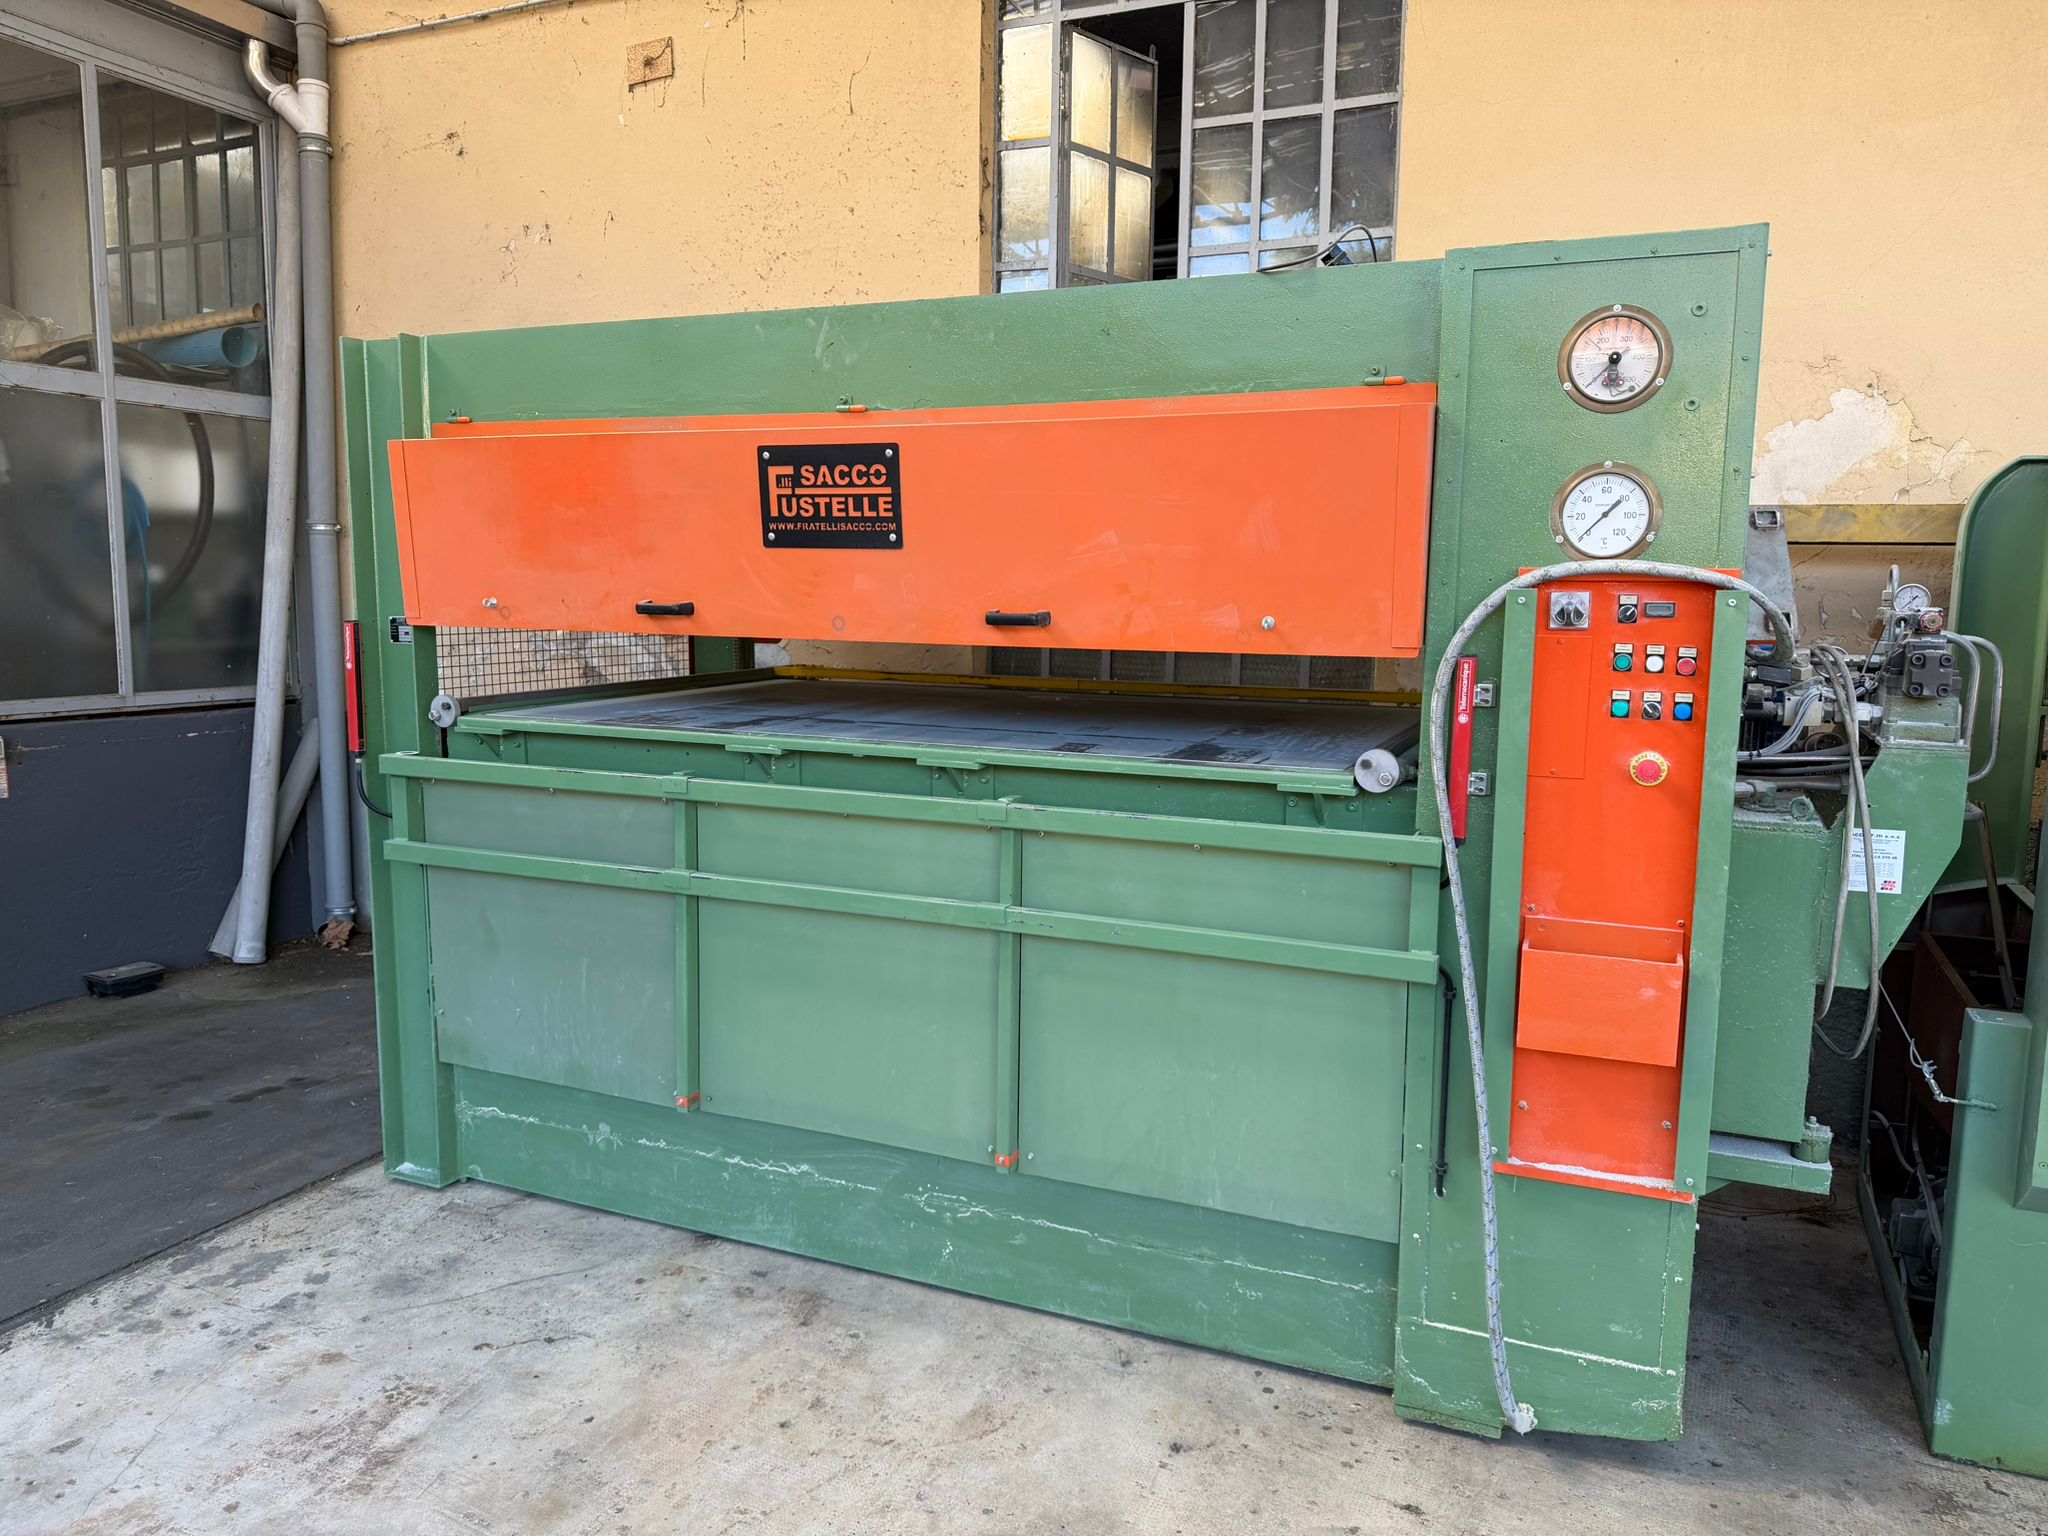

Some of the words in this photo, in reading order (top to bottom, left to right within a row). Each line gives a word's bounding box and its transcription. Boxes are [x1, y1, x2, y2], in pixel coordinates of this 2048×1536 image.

[1632, 353, 1646, 361] 400
[800, 463, 887, 485] SACCO
[1602, 486, 1612, 494] 60
[769, 522, 897, 531] WWW.FRATELLISACCO.COM
[1601, 537, 1607, 545] °C
[1460, 663, 1470, 711] Telemecanique
